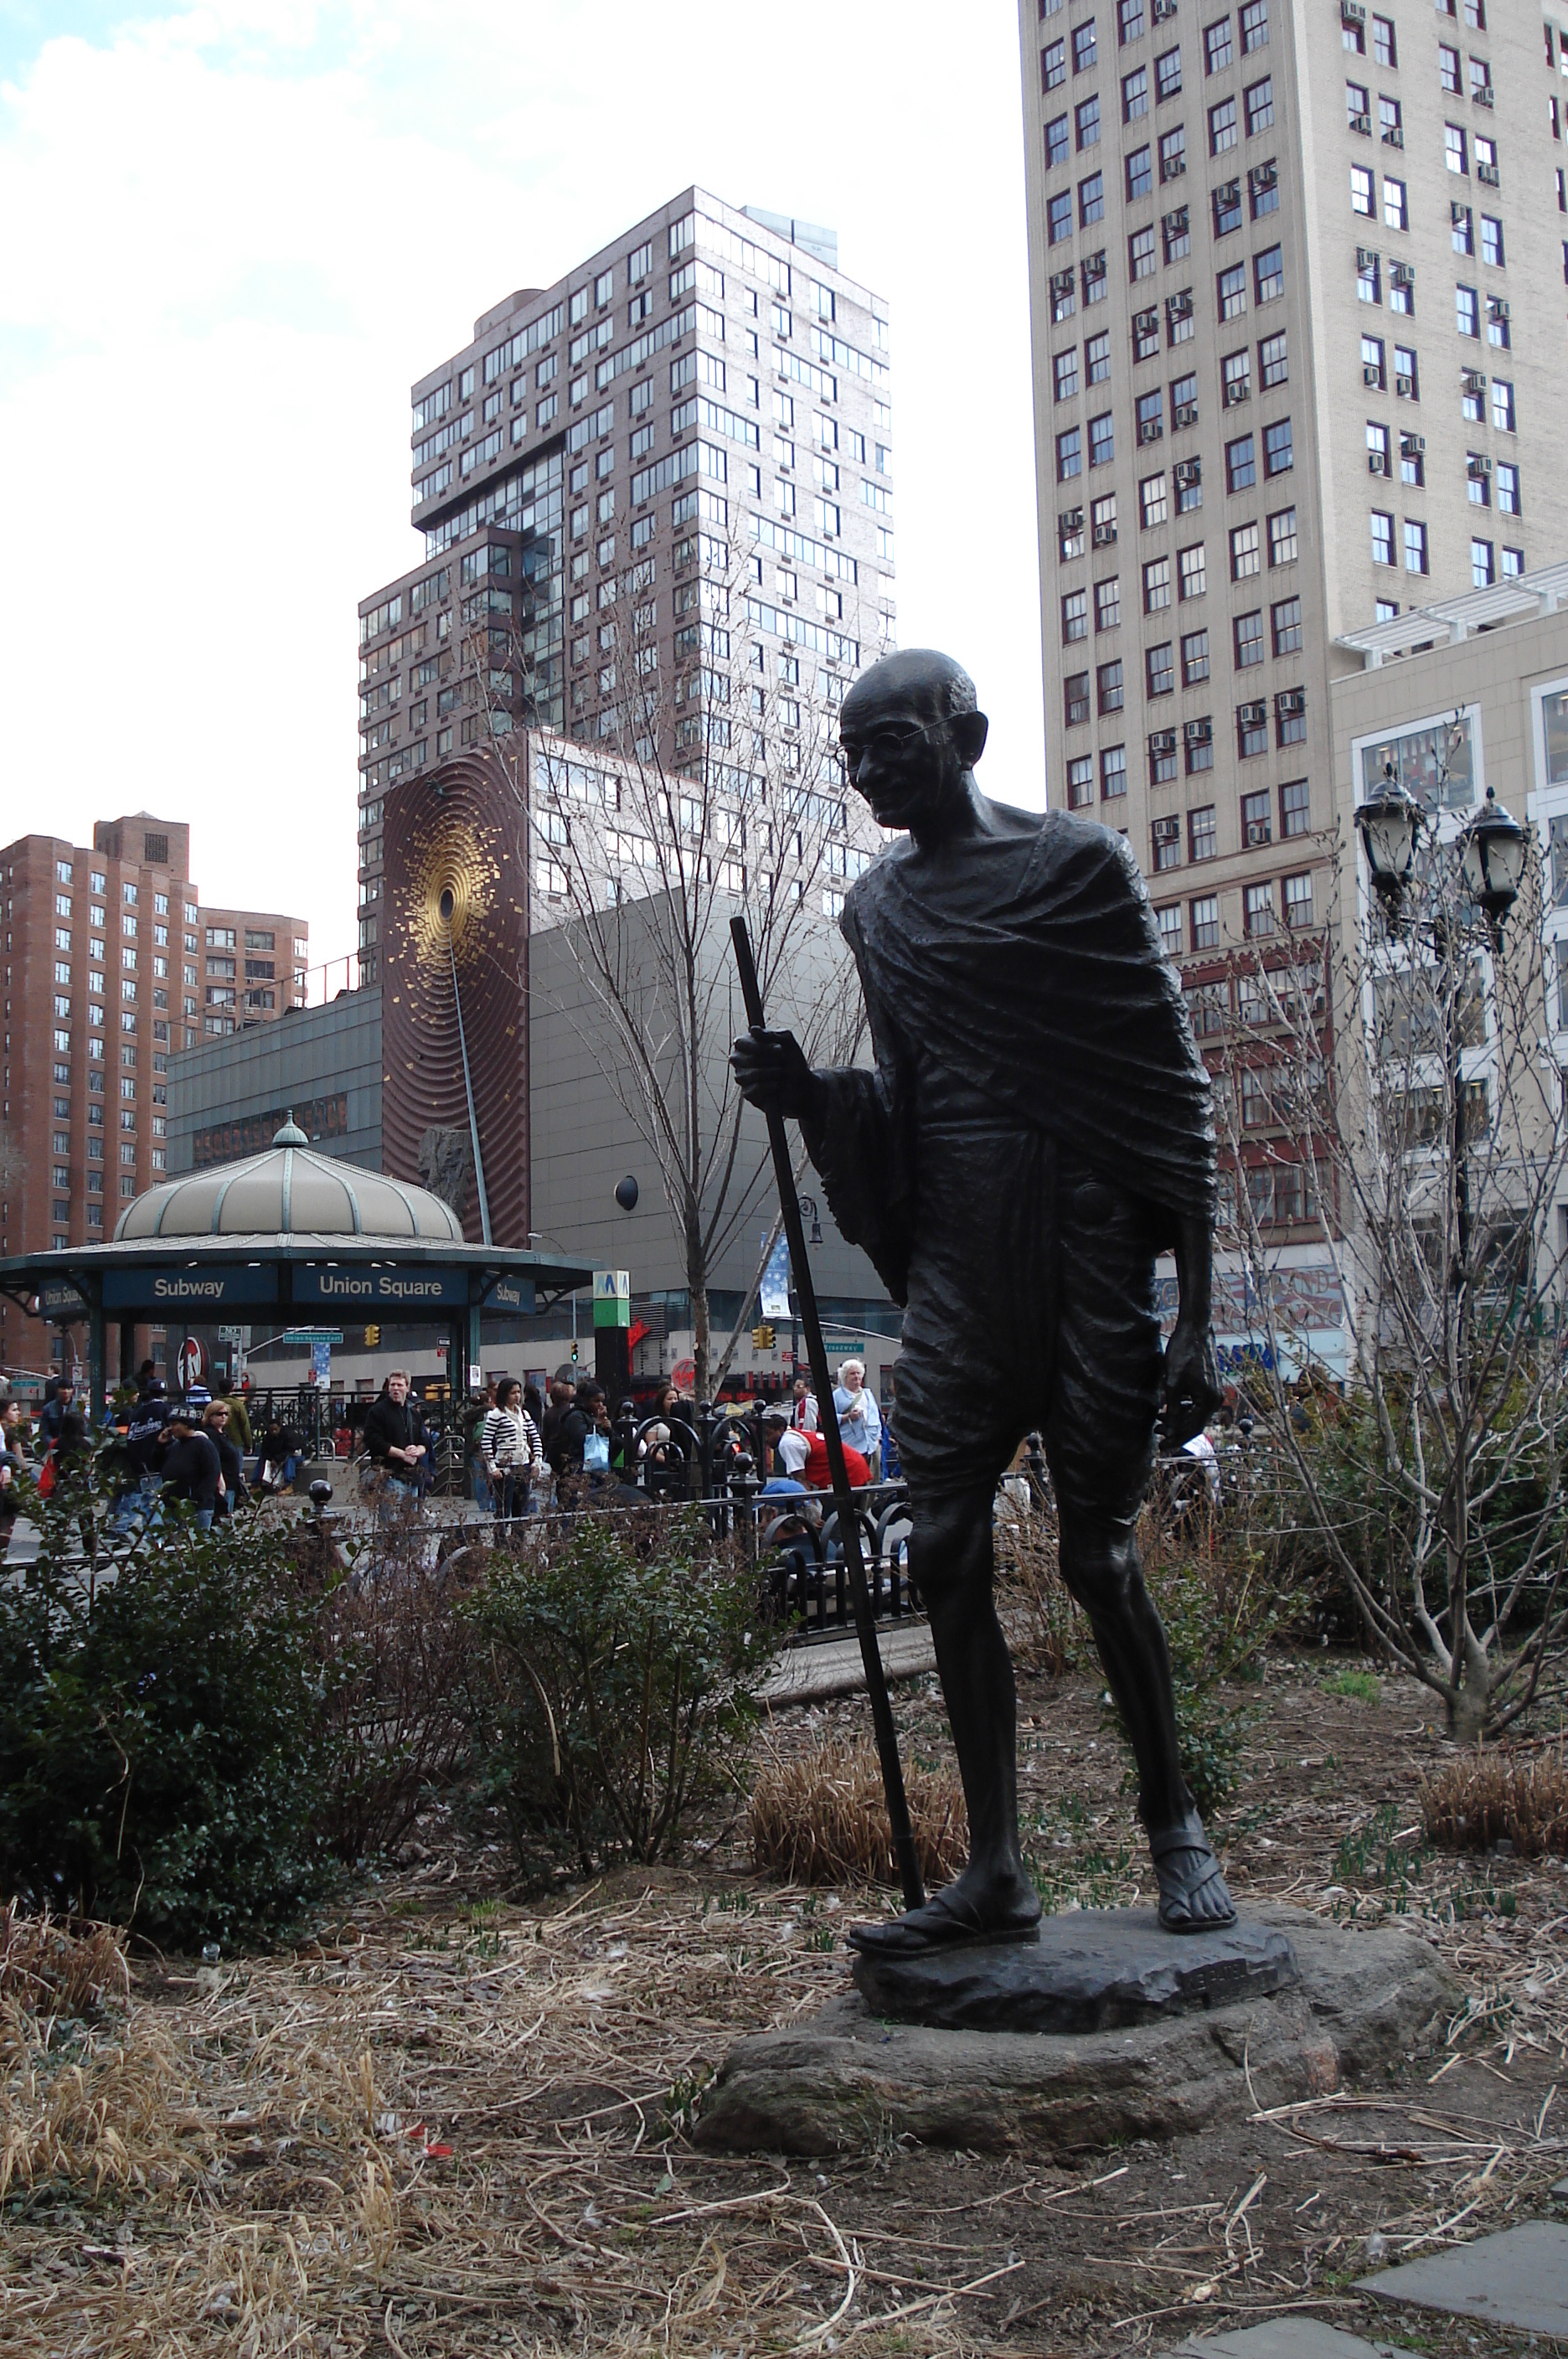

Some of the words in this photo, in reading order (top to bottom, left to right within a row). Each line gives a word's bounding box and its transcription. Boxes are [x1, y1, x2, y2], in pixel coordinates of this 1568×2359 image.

[45, 1289, 62, 1305] Union
[63, 1286, 83, 1305] Squa
[154, 1278, 224, 1298] Subway
[320, 1276, 373, 1294] Union
[379, 1277, 443, 1298] Square
[497, 1283, 520, 1306] Subway
